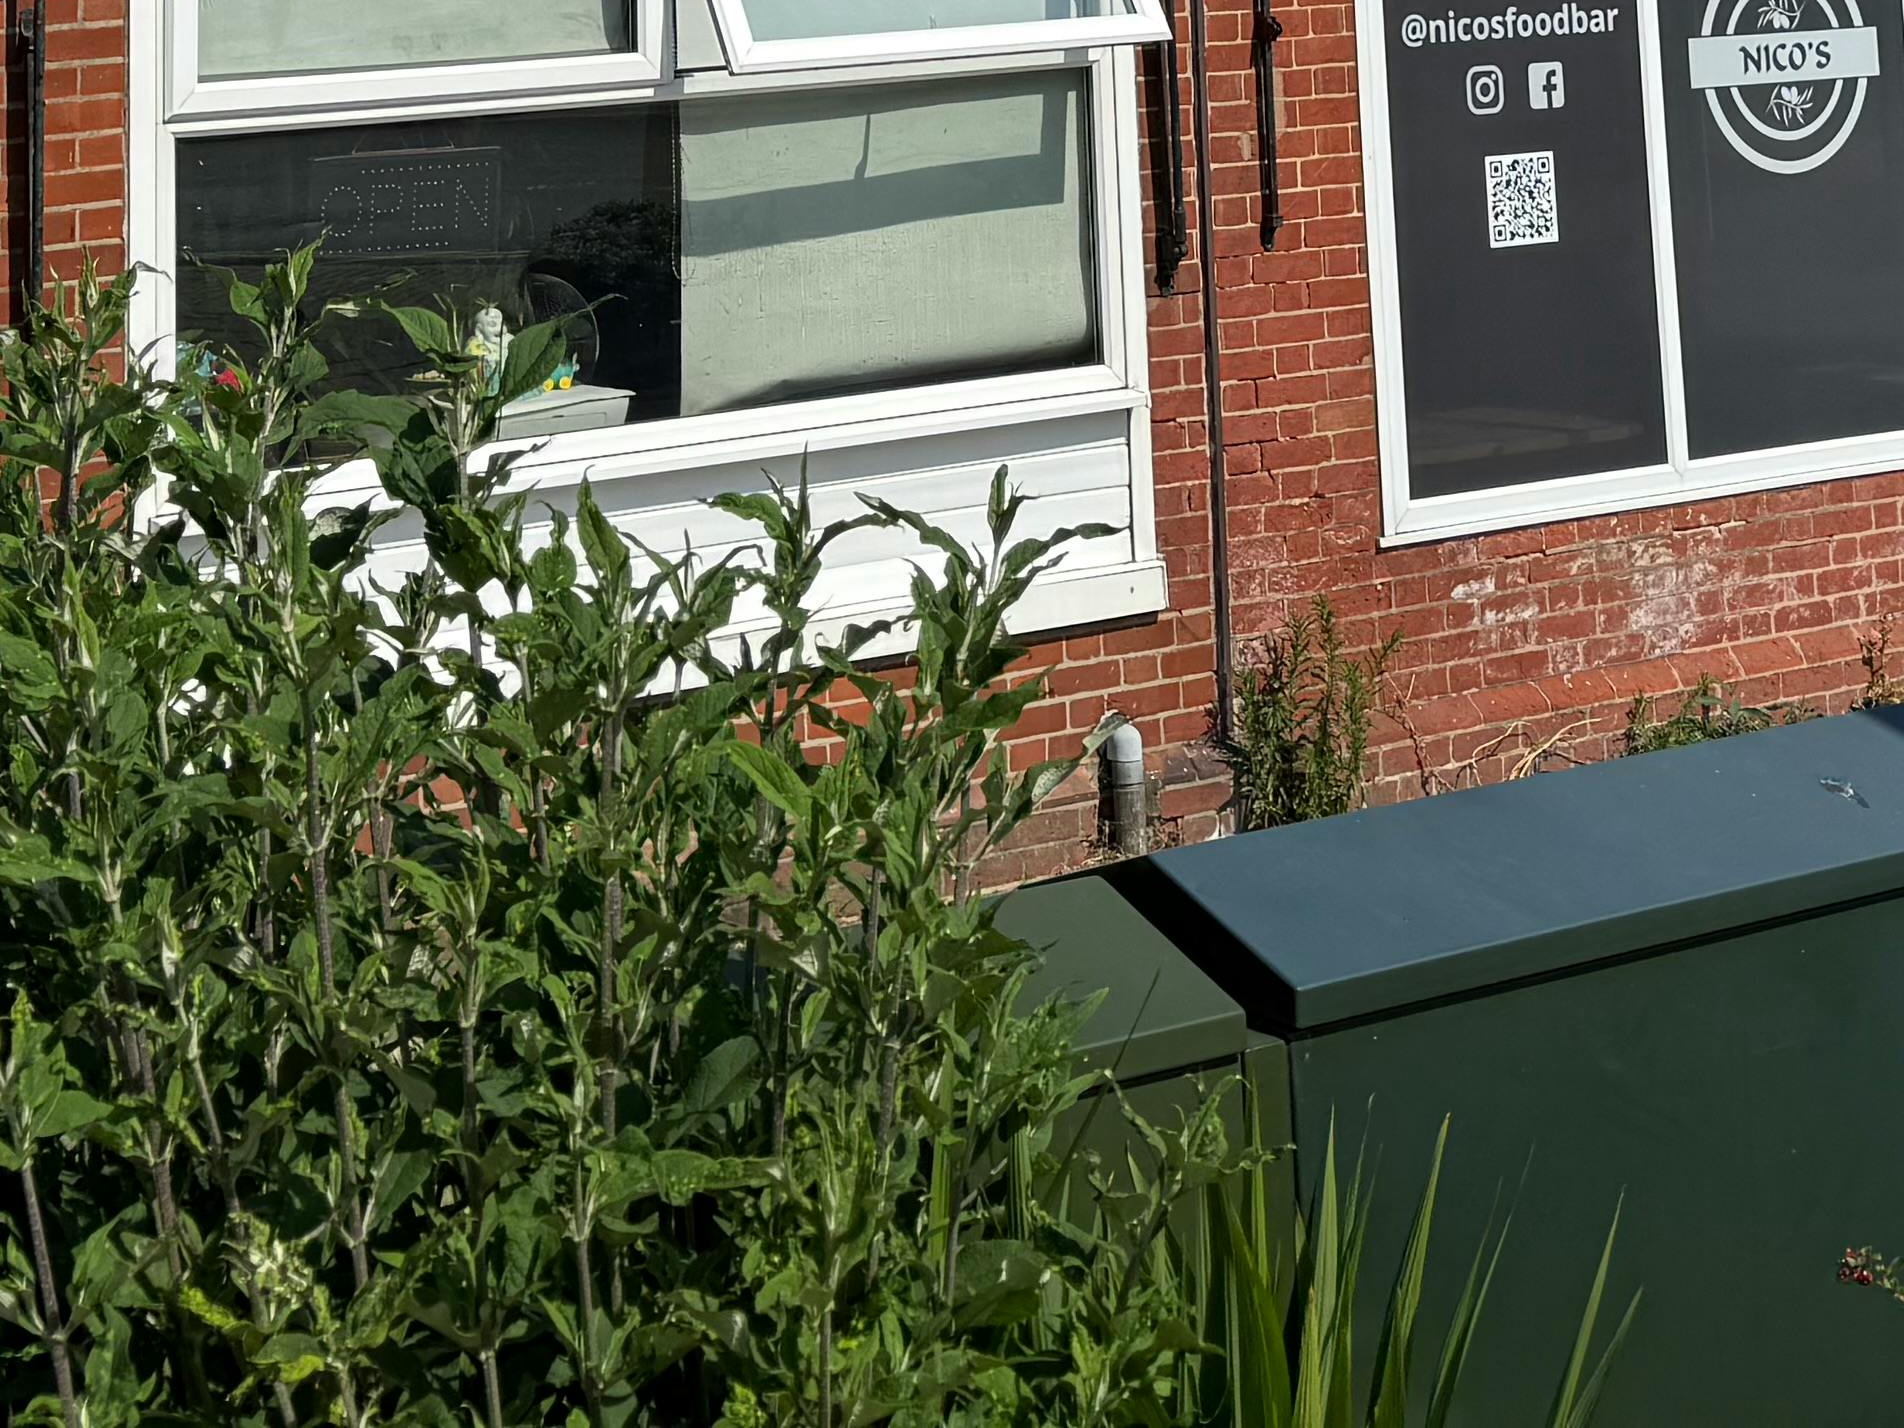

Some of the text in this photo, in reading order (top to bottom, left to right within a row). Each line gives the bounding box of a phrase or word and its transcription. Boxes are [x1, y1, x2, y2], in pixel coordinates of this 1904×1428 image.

[1401, 3, 1619, 48] @nicosfoodbar
[1739, 40, 1831, 75] NICO'S
[321, 177, 489, 236] OPEN
